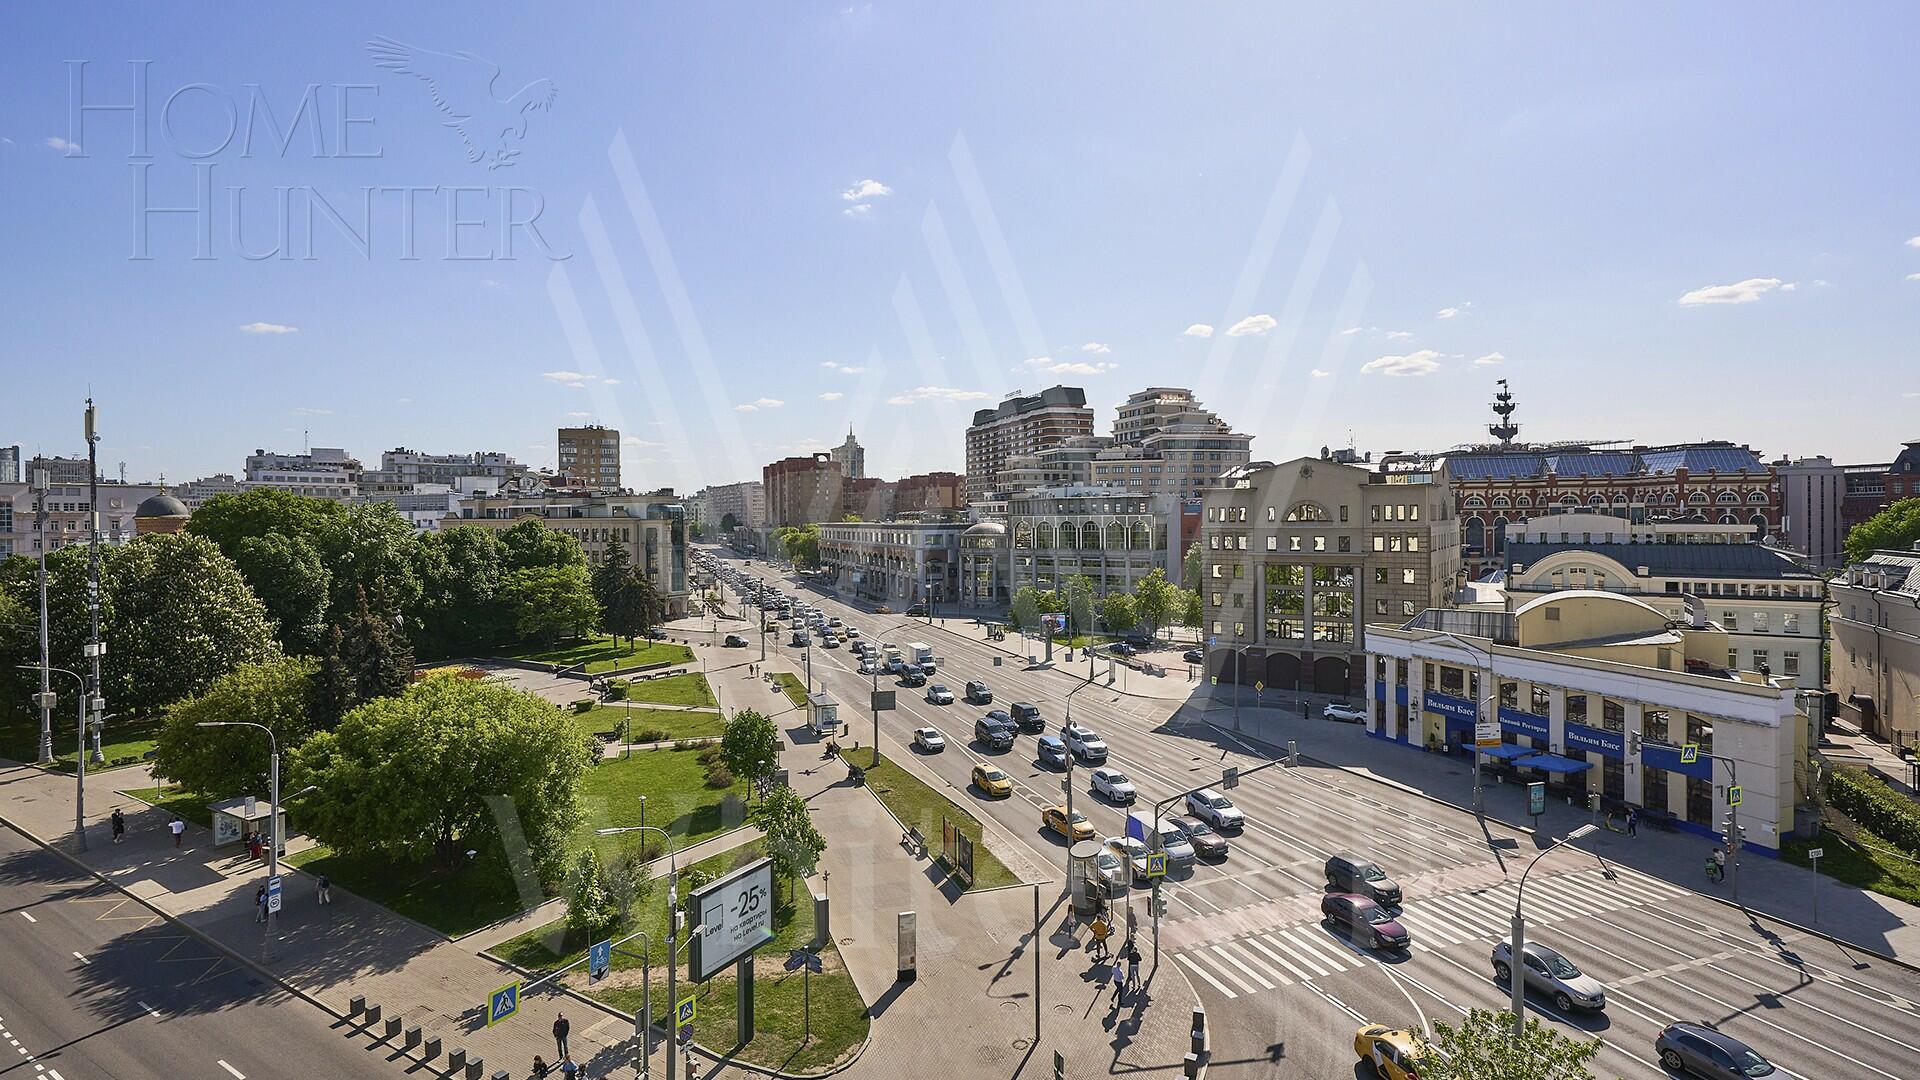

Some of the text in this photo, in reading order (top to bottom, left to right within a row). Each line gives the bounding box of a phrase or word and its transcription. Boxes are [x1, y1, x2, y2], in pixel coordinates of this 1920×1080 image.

[1427, 699, 1475, 717] Вильям Басс
[1568, 731, 1621, 752] Вильям Басс
[730, 885, 767, 918] -25%
[705, 921, 724, 938] Level
[730, 908, 768, 934] на квартиры
[733, 919, 765, 942] на Level.ru
